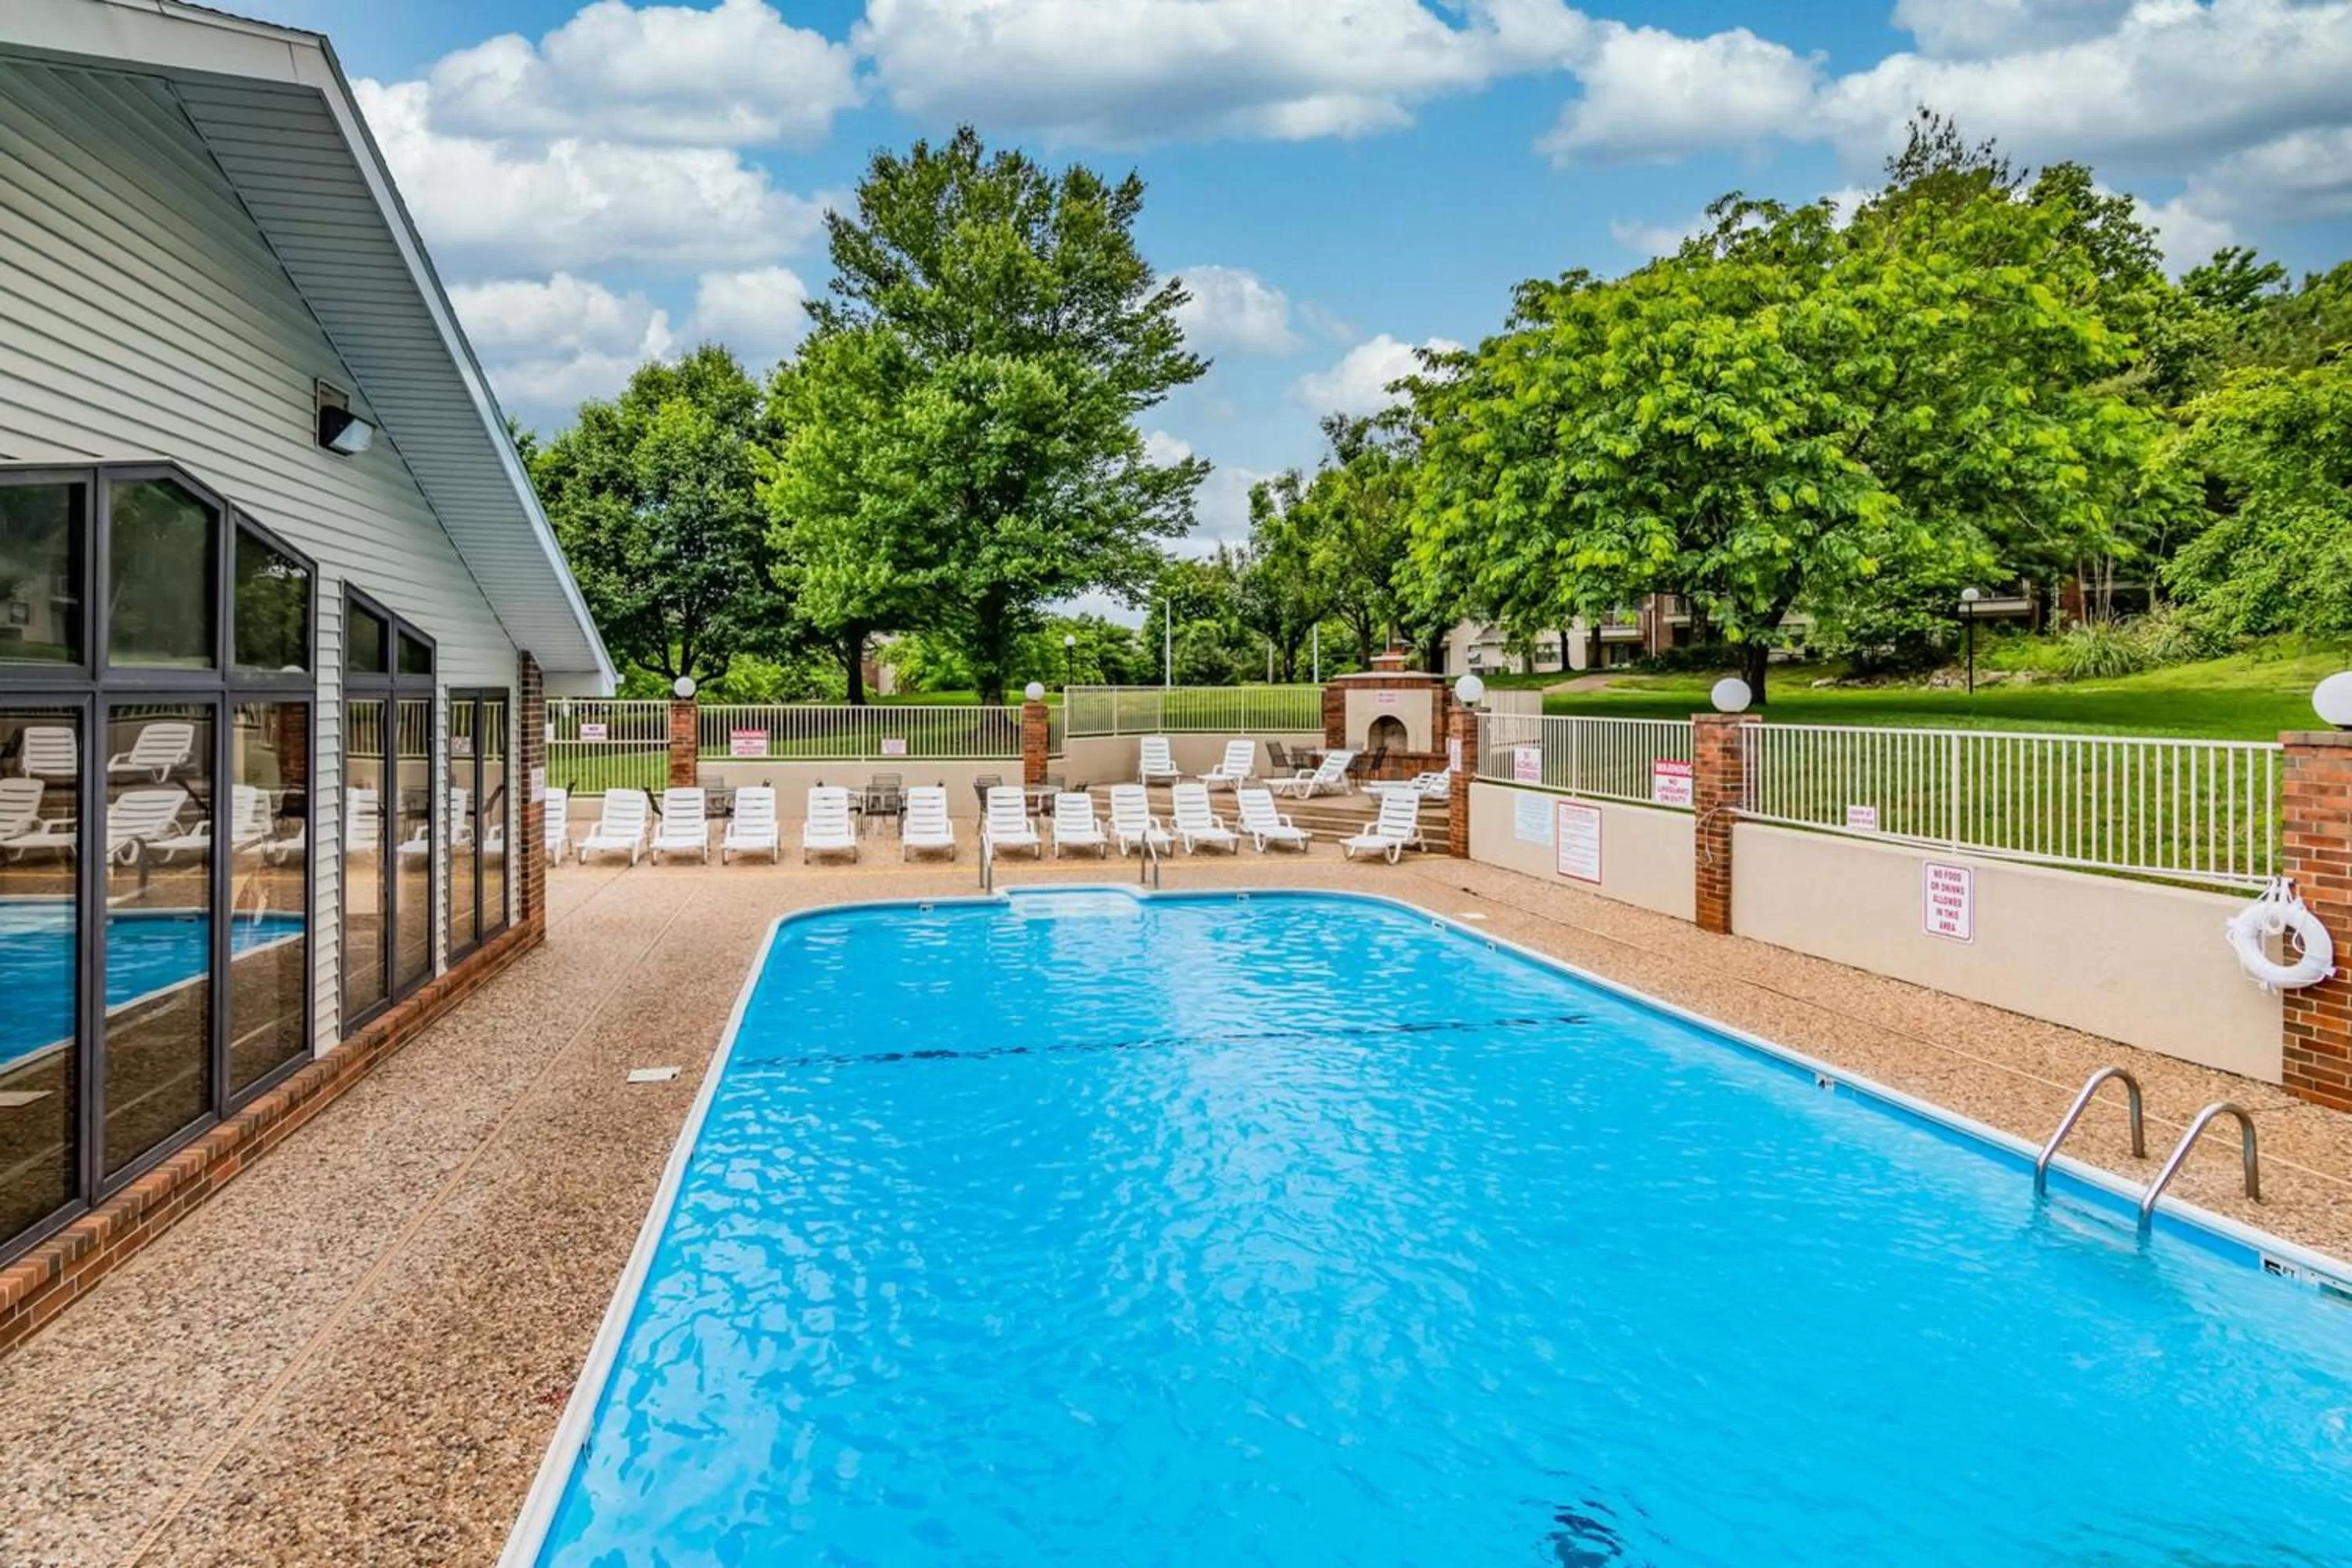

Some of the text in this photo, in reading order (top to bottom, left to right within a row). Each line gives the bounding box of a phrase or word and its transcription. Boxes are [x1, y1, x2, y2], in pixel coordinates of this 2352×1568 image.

[1933, 869, 1962, 883] NO FOOD
[1931, 881, 1965, 895] OR DRINKS
[1933, 895, 1962, 908] ALLOWED
[1936, 908, 1958, 920] IN THIS
[1939, 920, 1956, 932] AREA
